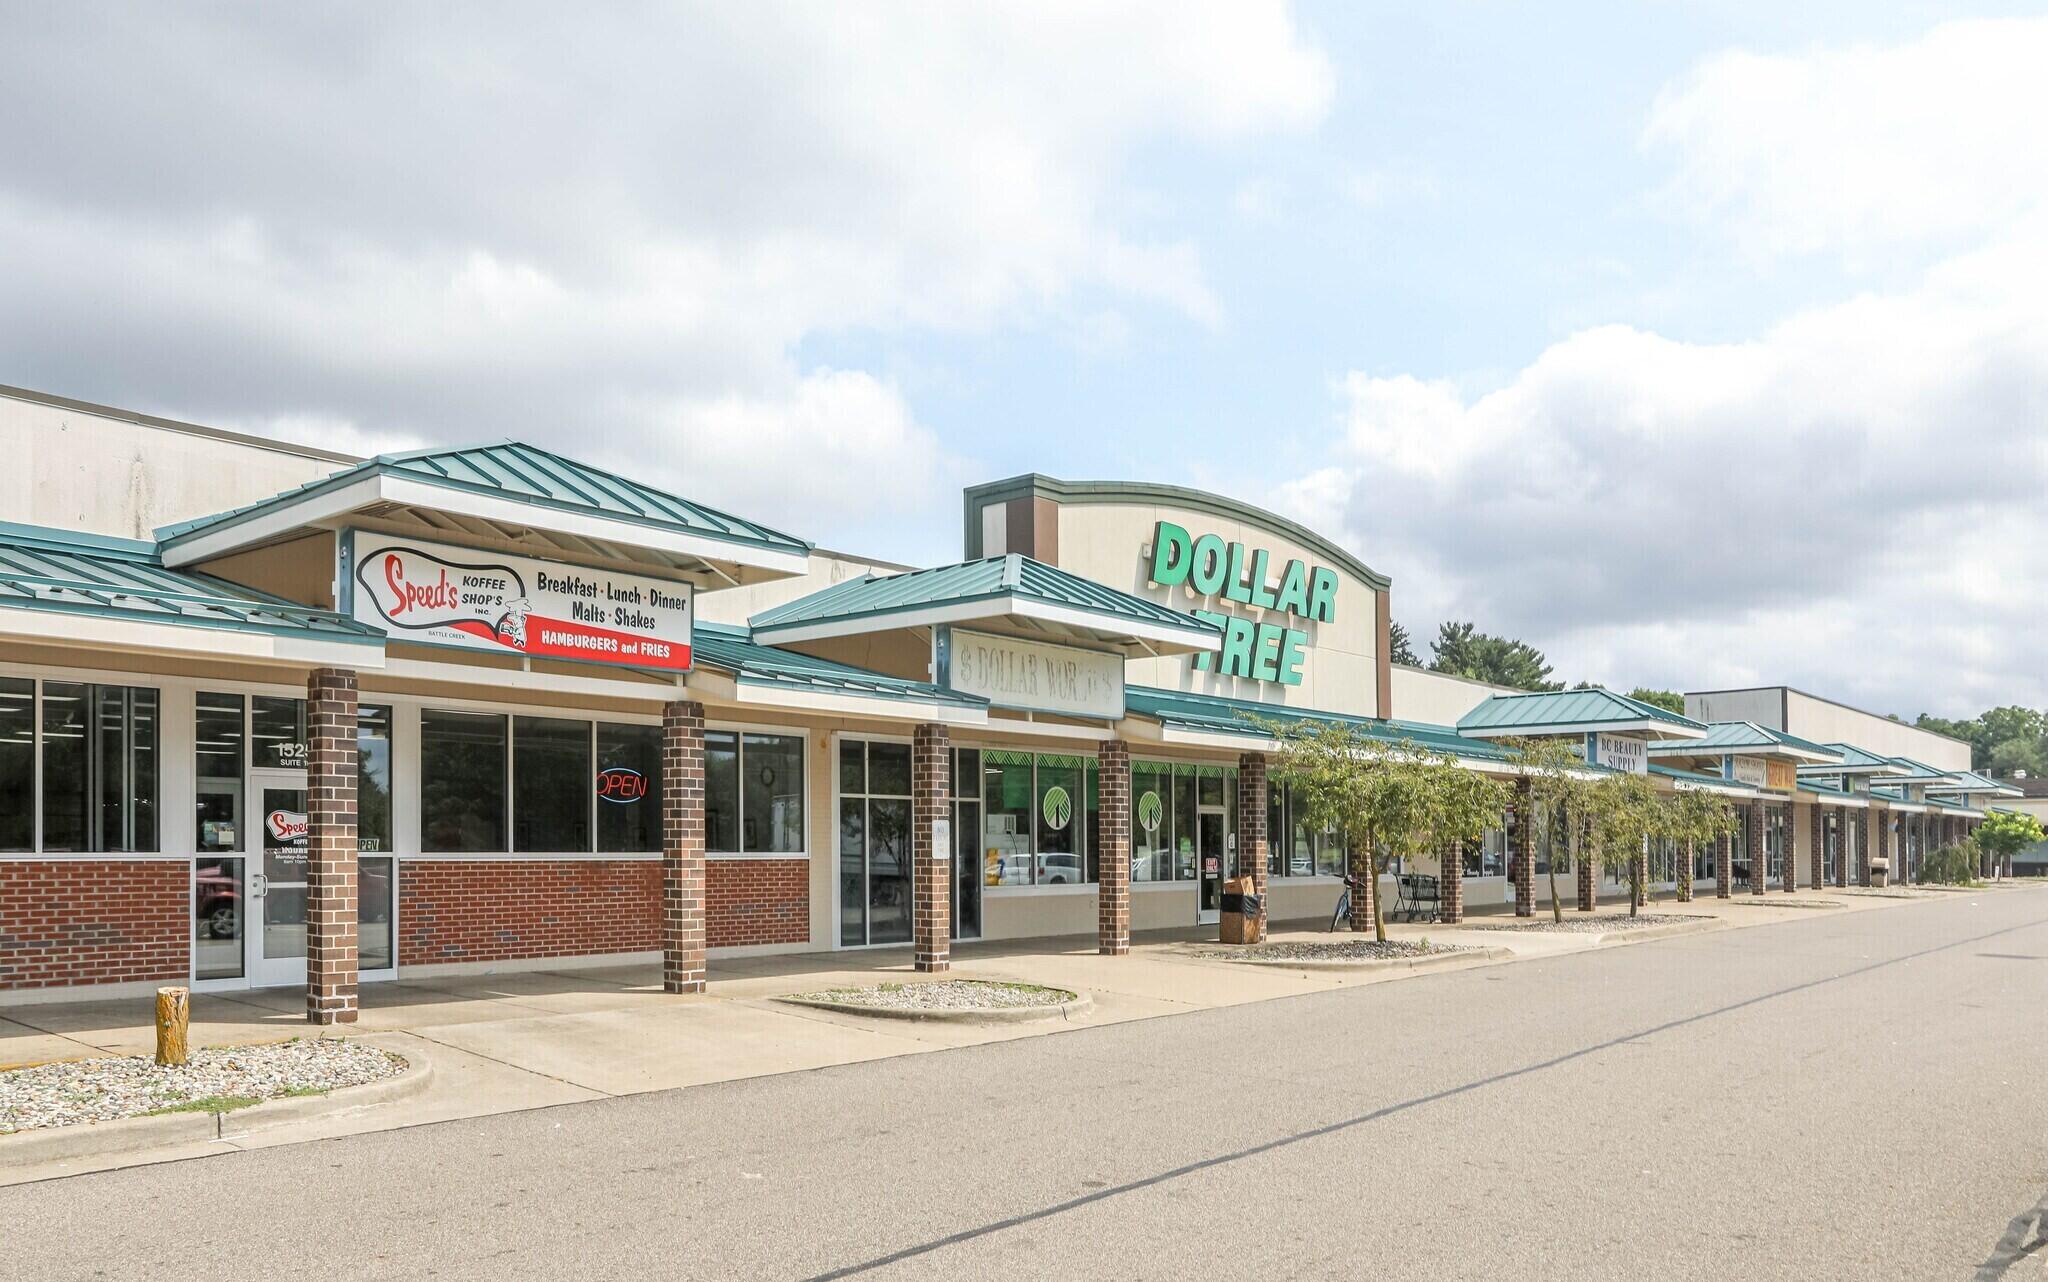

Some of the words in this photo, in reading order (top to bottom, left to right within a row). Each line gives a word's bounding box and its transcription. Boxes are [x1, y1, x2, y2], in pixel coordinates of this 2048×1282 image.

[462, 575, 506, 590] KOFFEE
[1148, 520, 1339, 624] DOLLAR
[384, 554, 458, 616] Speed's
[537, 571, 598, 598] Breakfast
[607, 581, 641, 605] Lunch
[650, 588, 686, 611] Dinner
[461, 593, 503, 606] SHOP'S
[474, 608, 491, 616] INC.
[572, 600, 606, 623] Malts
[615, 606, 656, 630] Shakes
[428, 630, 447, 638] BATTLE
[448, 632, 466, 640] CREEK
[541, 630, 618, 653] HAMBURGERS
[621, 642, 638, 654] and
[641, 642, 671, 658] FRIES
[1190, 609, 1309, 686] TREE
[977, 646, 1039, 697] DOLLAR
[1601, 737, 1612, 752] BC
[1614, 740, 1643, 757] BEAUTY
[280, 758, 301, 767] SUITE
[1608, 754, 1637, 771] SUPPLY
[596, 773, 647, 798] OPEN
[357, 839, 378, 851] PEN
